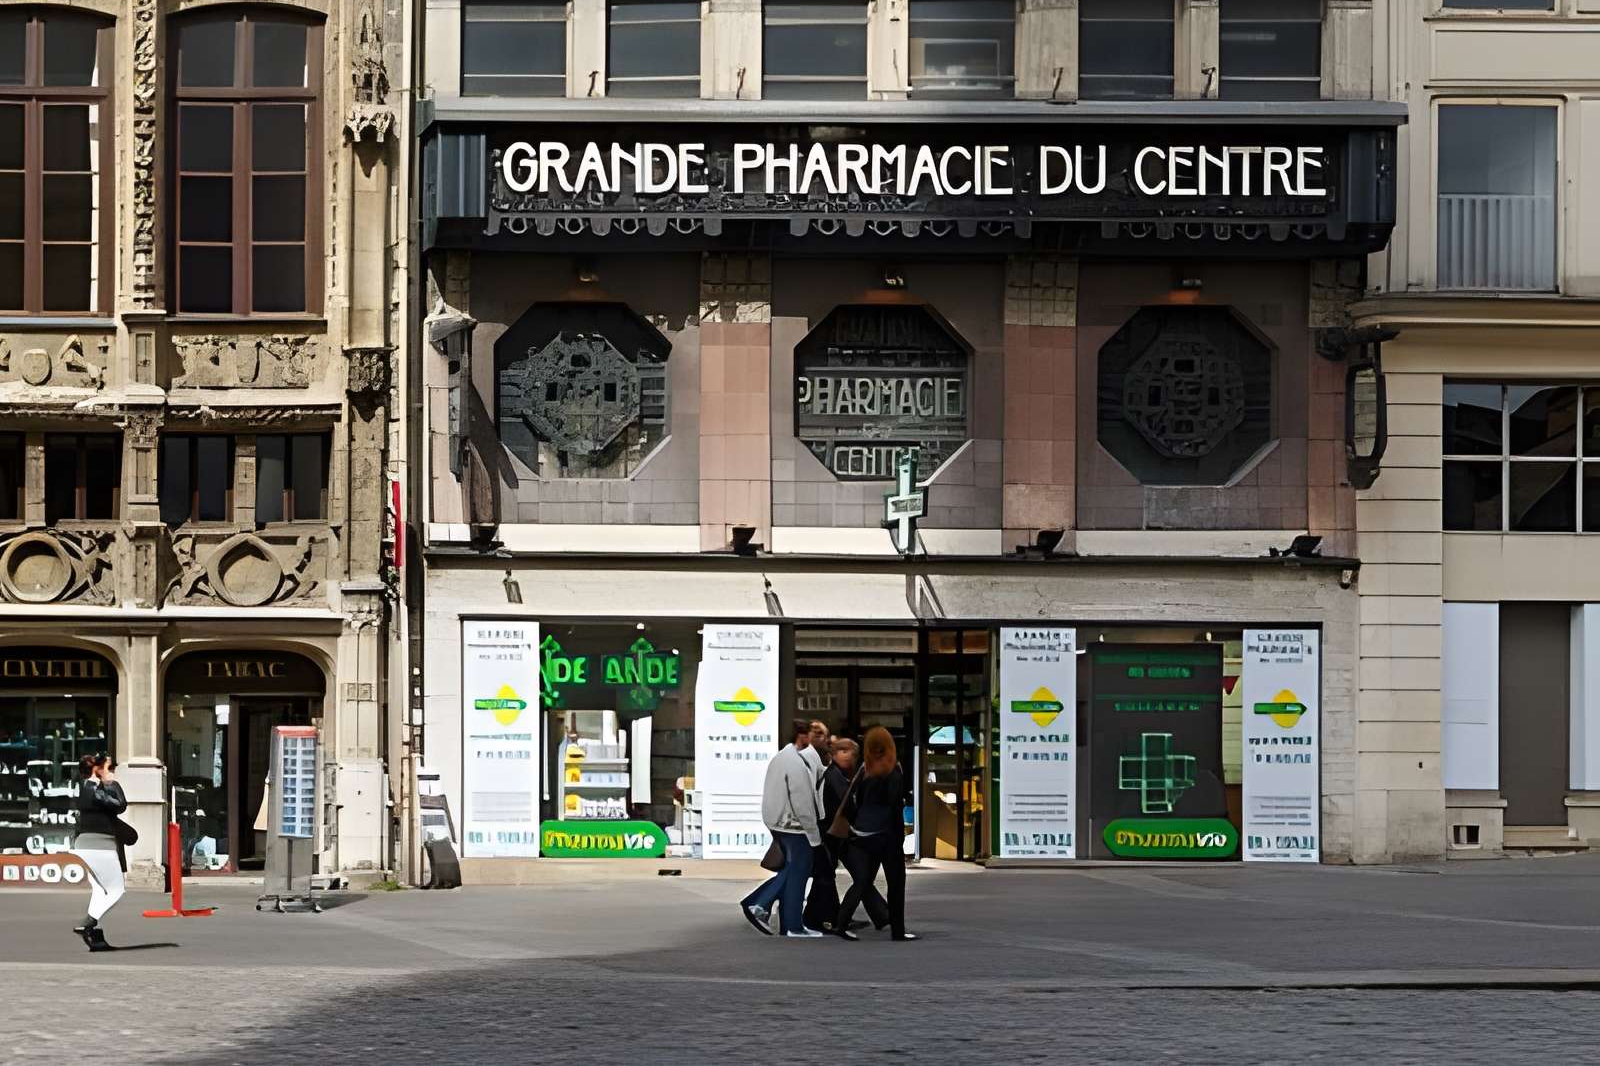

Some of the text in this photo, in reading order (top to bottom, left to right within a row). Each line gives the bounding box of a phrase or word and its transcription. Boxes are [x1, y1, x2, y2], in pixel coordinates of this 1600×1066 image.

[502, 141, 1327, 197] GRANDE PHARMACIE DU CENTRE
[797, 376, 962, 416] PHARMACIE
